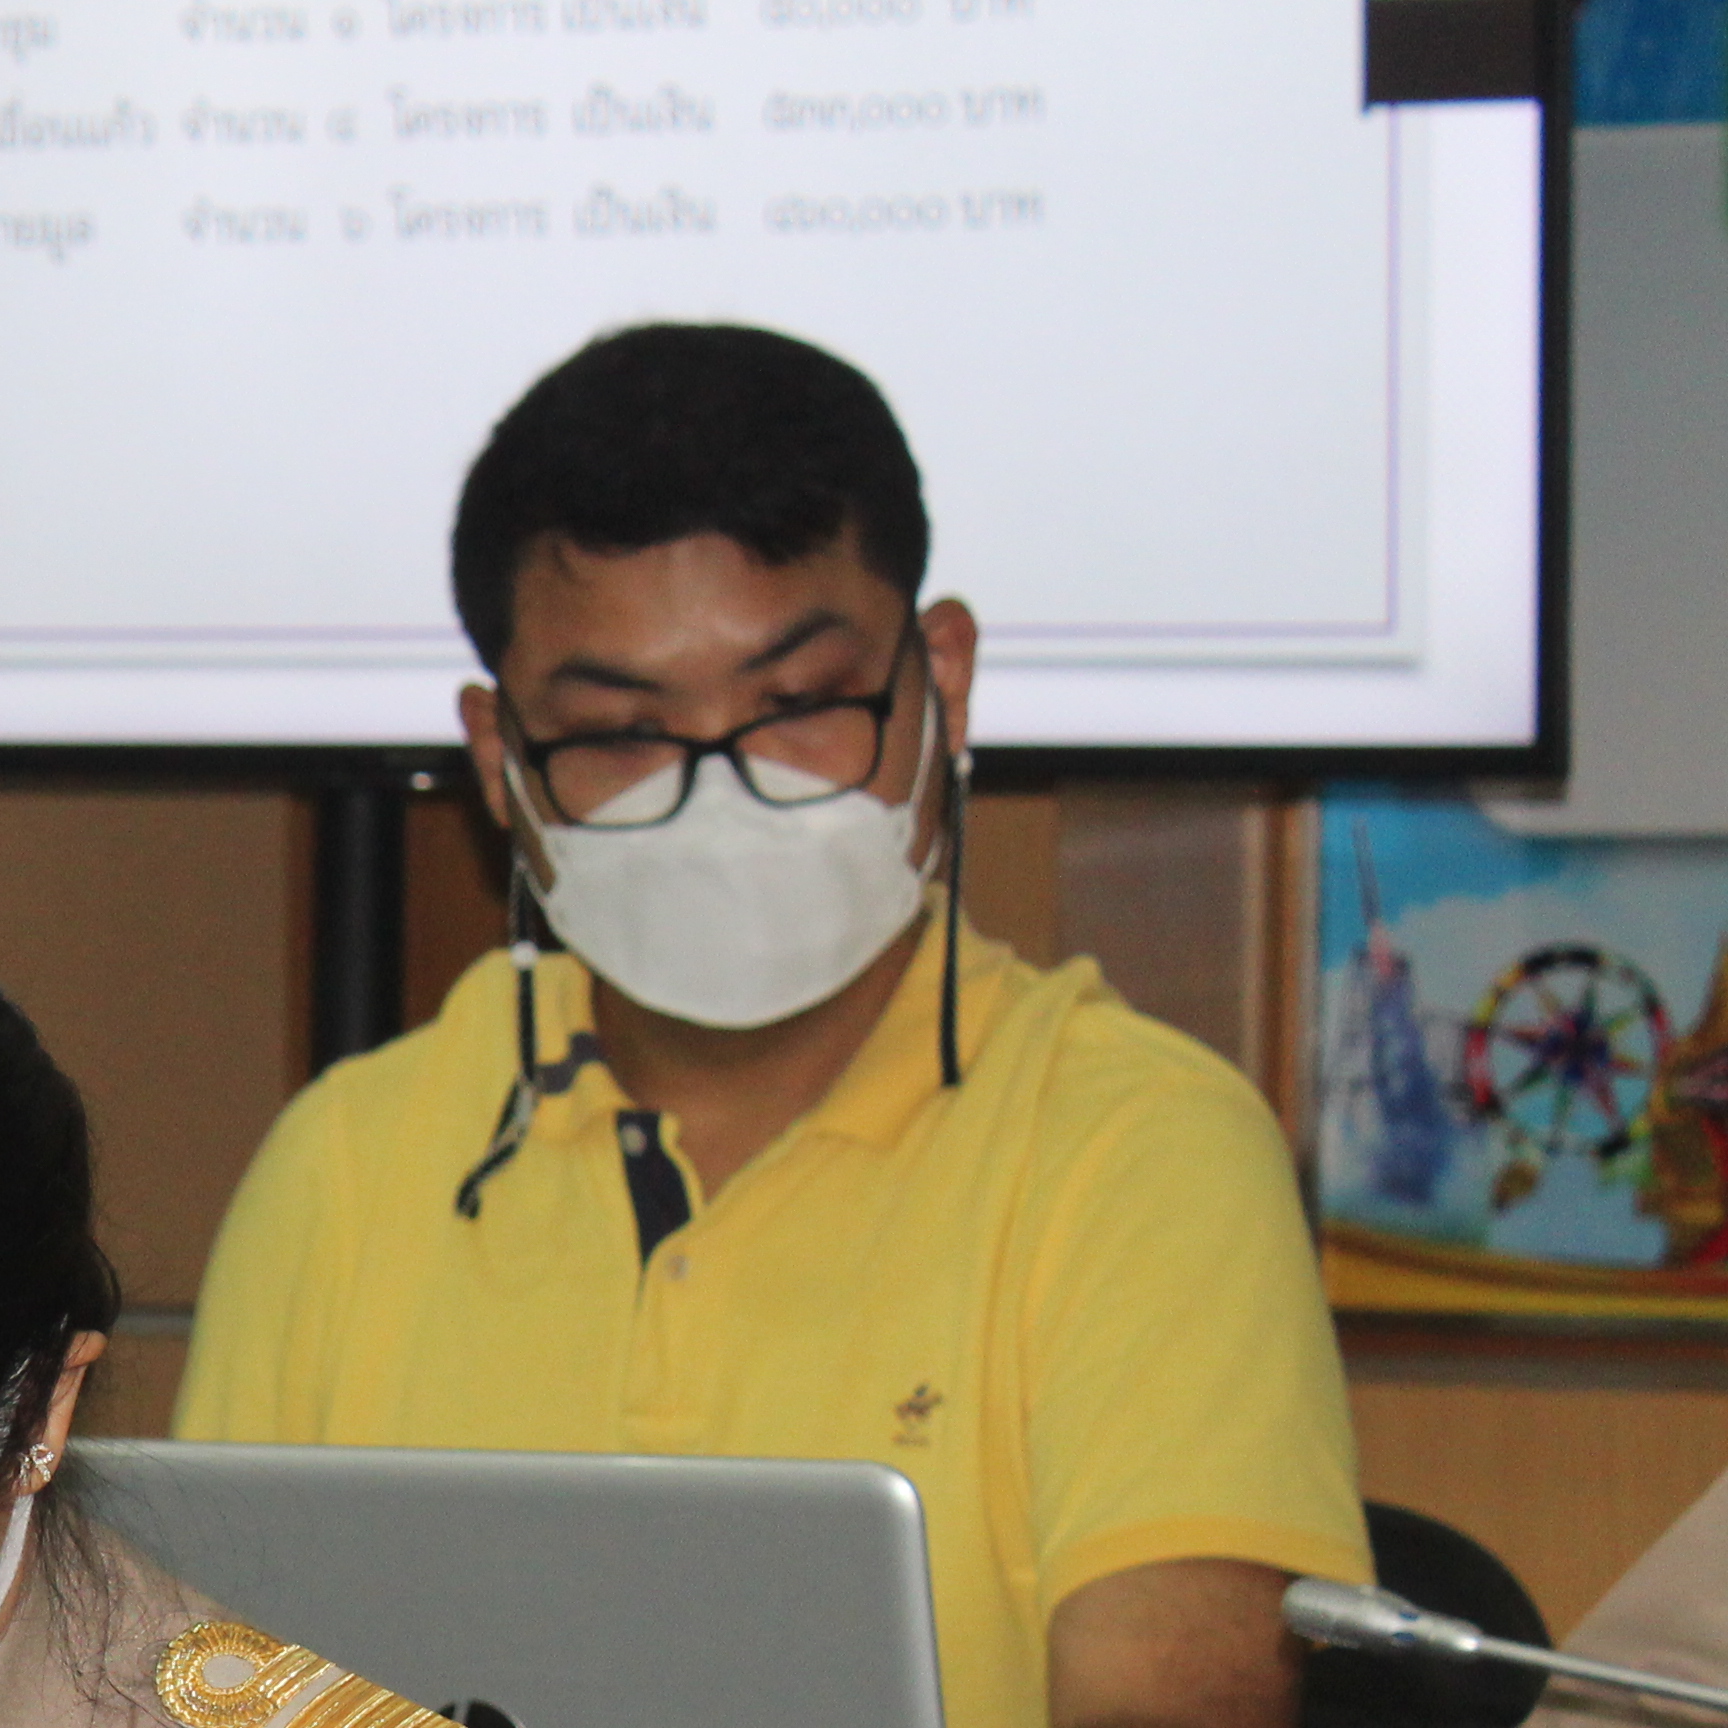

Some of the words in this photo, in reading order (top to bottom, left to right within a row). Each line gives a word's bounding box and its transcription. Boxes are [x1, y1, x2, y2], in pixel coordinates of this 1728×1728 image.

[180, 97, 307, 145] จำนวน
[386, 85, 547, 141] โครงการ
[572, 81, 715, 136] เป็นเงิน
[960, 86, 1046, 127] บาท
[181, 195, 308, 245] จำนวน
[386, 185, 548, 242] โครงการ
[573, 183, 717, 236] เป็นเงิน
[959, 189, 1045, 231] บาท
